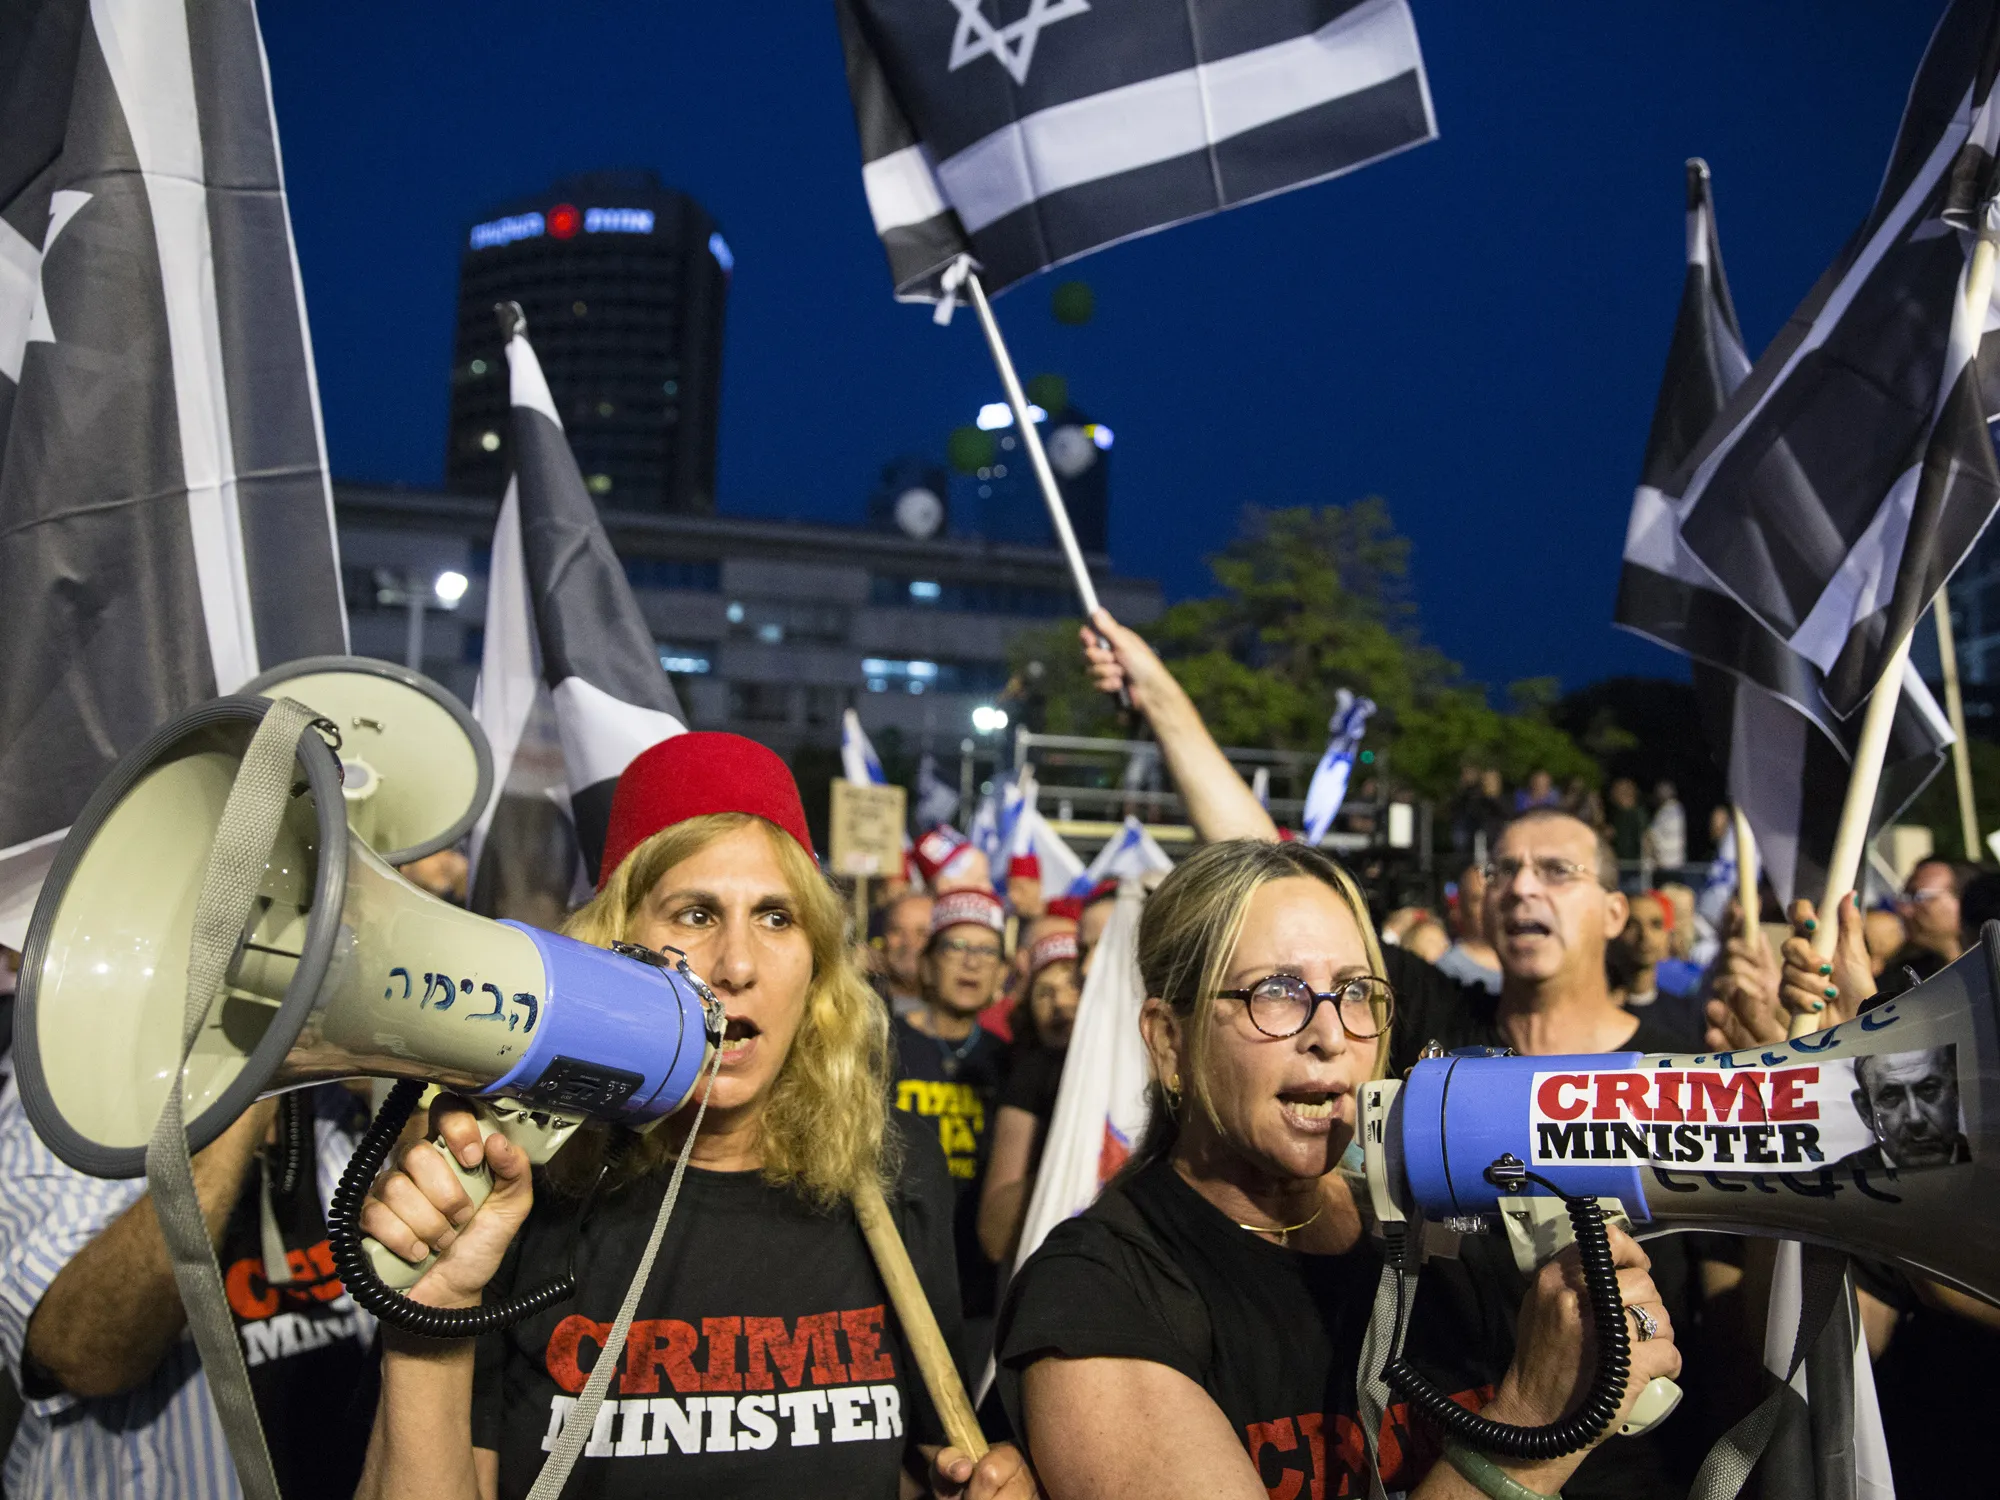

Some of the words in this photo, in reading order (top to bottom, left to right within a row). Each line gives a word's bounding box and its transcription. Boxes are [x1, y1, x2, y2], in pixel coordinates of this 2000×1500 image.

[384, 967, 538, 1033] הבימה
[1537, 1067, 1820, 1122] CRIME
[1537, 1122, 1825, 1163] MINISTER
[546, 1304, 895, 1394] CRIME
